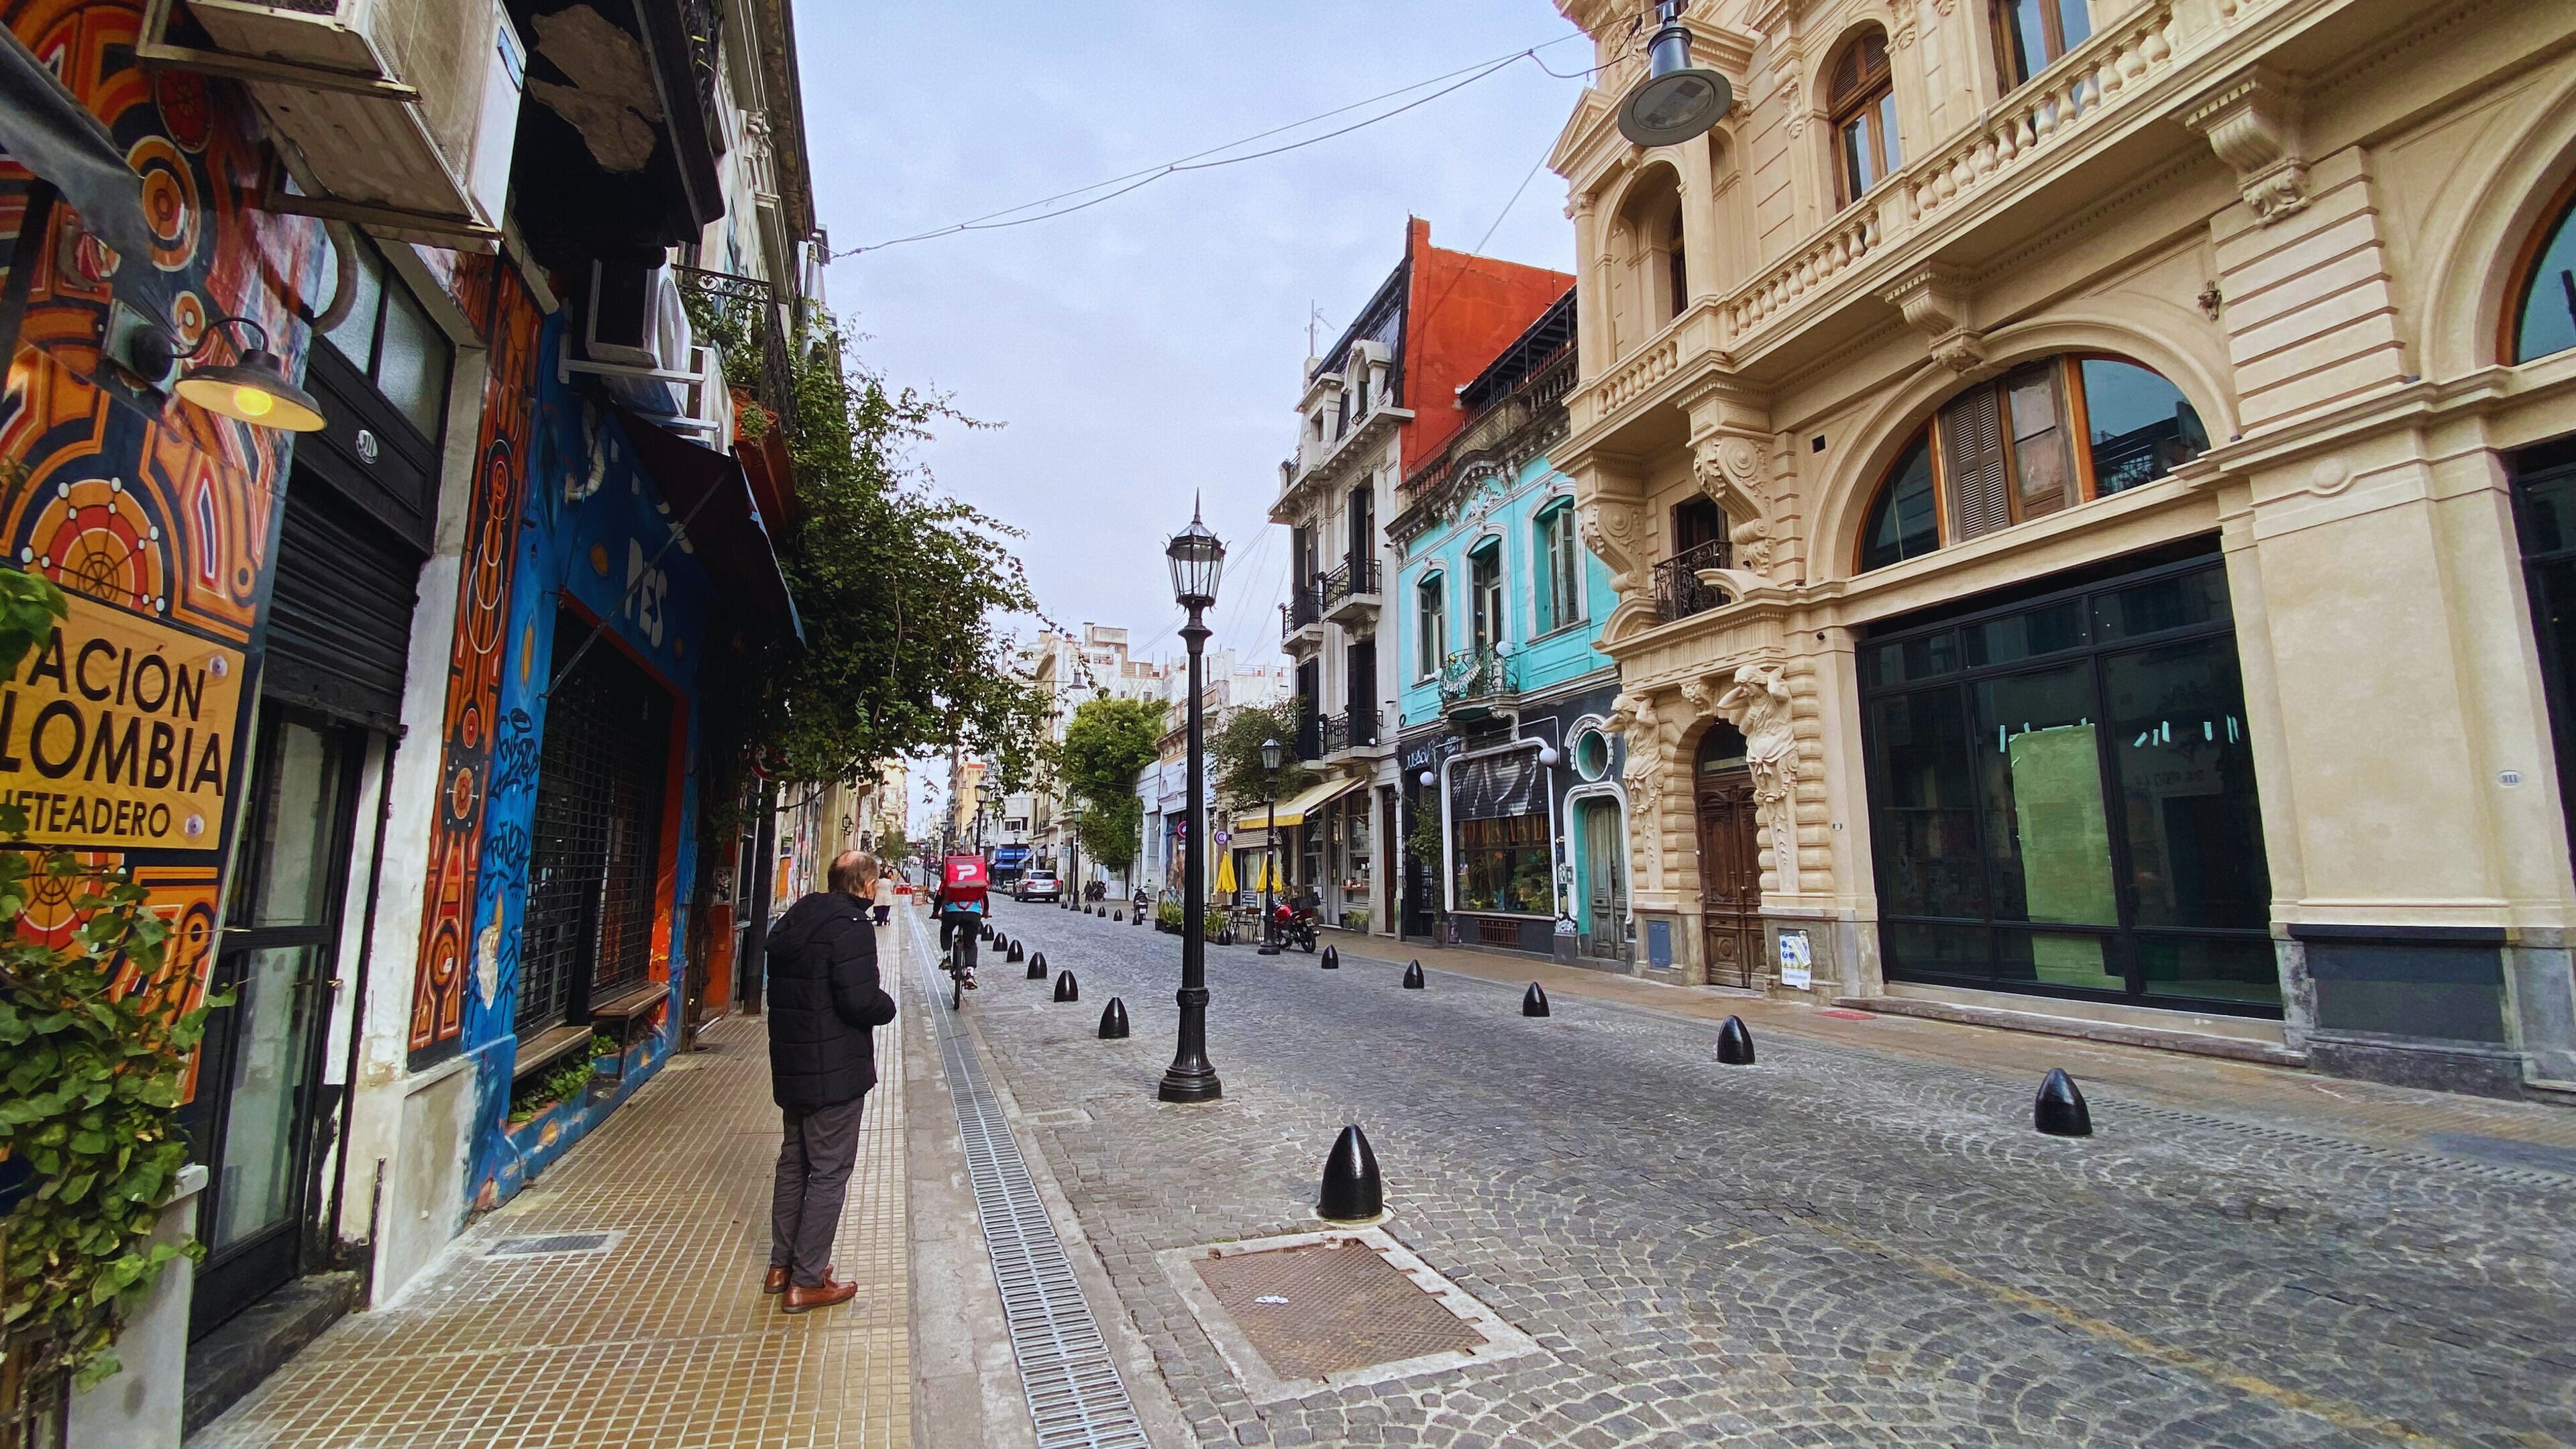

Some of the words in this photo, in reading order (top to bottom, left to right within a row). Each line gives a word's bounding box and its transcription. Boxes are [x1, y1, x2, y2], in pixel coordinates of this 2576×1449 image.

[9, 627, 206, 722] ACIÓN
[0, 690, 224, 797] LOMBIA
[956, 864, 977, 881] P
